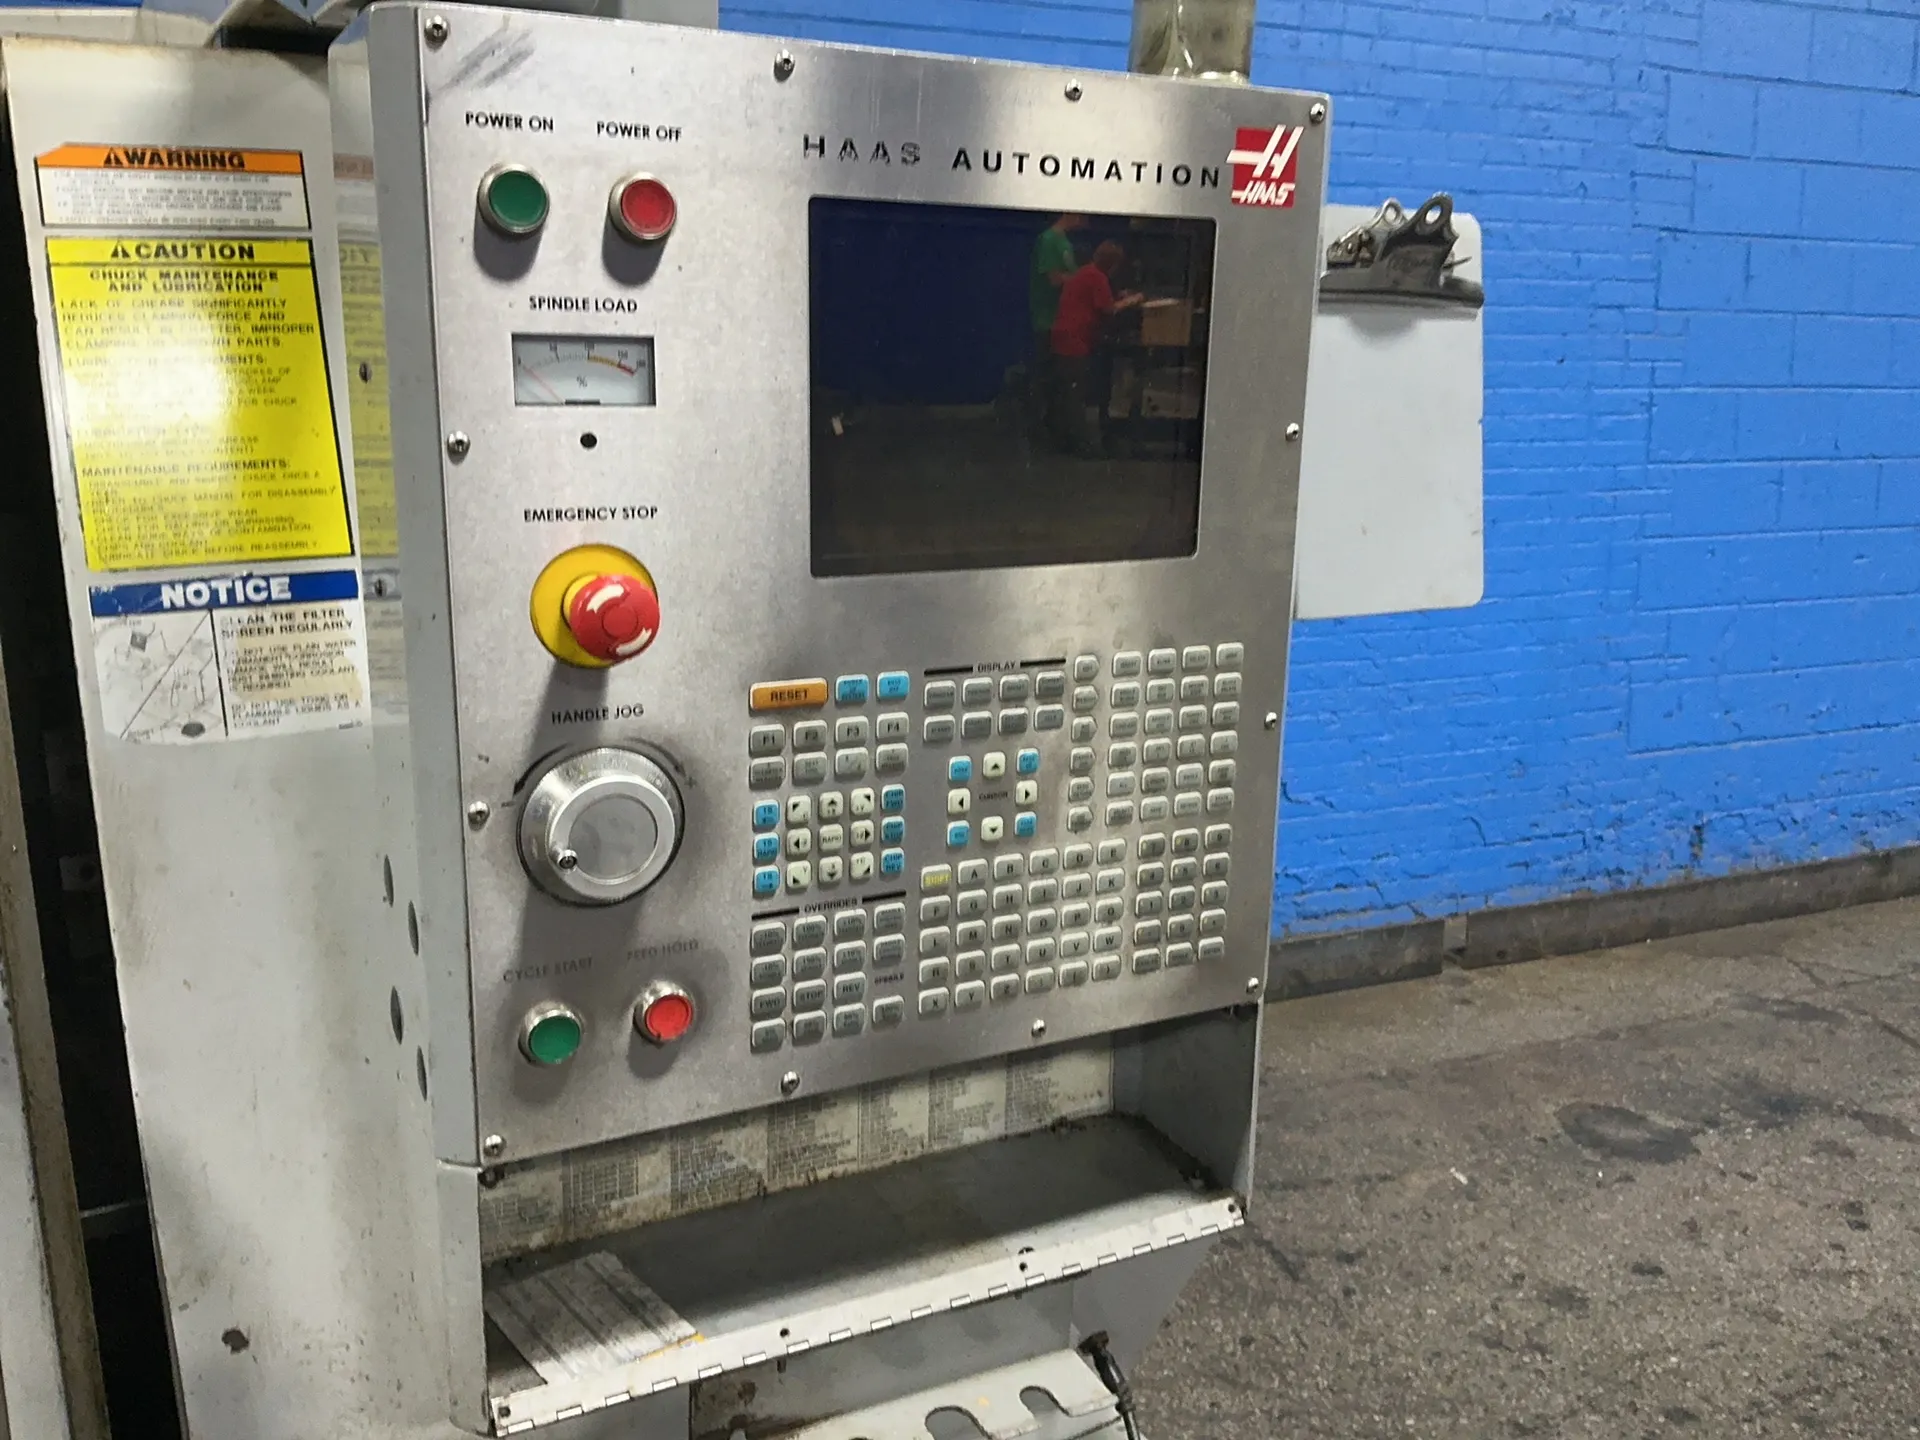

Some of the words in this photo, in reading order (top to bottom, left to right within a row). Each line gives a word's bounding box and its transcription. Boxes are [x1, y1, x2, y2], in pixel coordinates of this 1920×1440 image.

[464, 111, 524, 131] POWER
[528, 115, 554, 132] ON
[596, 121, 650, 140] POWER
[655, 125, 682, 143] OFF
[122, 147, 245, 169] WARNING
[802, 134, 922, 166] HAAS
[952, 147, 1220, 189] AUTOMATION
[1231, 180, 1296, 206] HAAS
[134, 243, 255, 260] CAUTION
[90, 269, 148, 281] CHUCK
[159, 270, 278, 282] MAINTENANCE
[109, 281, 143, 293] AND
[152, 281, 263, 293] LUBRICATION
[60, 298, 97, 309] LACK
[192, 298, 287, 309] SIGNIFICANTLY
[529, 295, 590, 313] SPINDLE
[594, 297, 638, 314] LOAD
[251, 323, 314, 334] IMPROPER
[82, 464, 179, 477] MAINTENANCE
[523, 507, 617, 523] EMERGENCY
[622, 505, 658, 521] STOP
[160, 576, 292, 609] NOTICE
[220, 613, 264, 625] CLEAN
[273, 611, 296, 622] THE
[303, 608, 345, 620] FILTER
[222, 625, 274, 638] SCREEN
[280, 620, 353, 634] REGULARLY
[977, 661, 1017, 673] DISPLAY
[770, 688, 809, 703] RESET
[551, 707, 609, 725] HANDLE
[613, 703, 644, 720] JOG
[847, 725, 860, 738] F3
[887, 721, 900, 734] F4
[763, 733, 775, 746] F1
[805, 729, 818, 742] F2
[822, 834, 842, 844] RAPID
[804, 898, 858, 913] OVERRIDES
[626, 946, 658, 962] FEED
[661, 938, 699, 957] HOLD
[502, 966, 549, 984] CYCLE
[554, 956, 594, 976] START
[800, 990, 822, 1001] STOP
[842, 983, 861, 993] REV
[759, 999, 780, 1009] FWD
